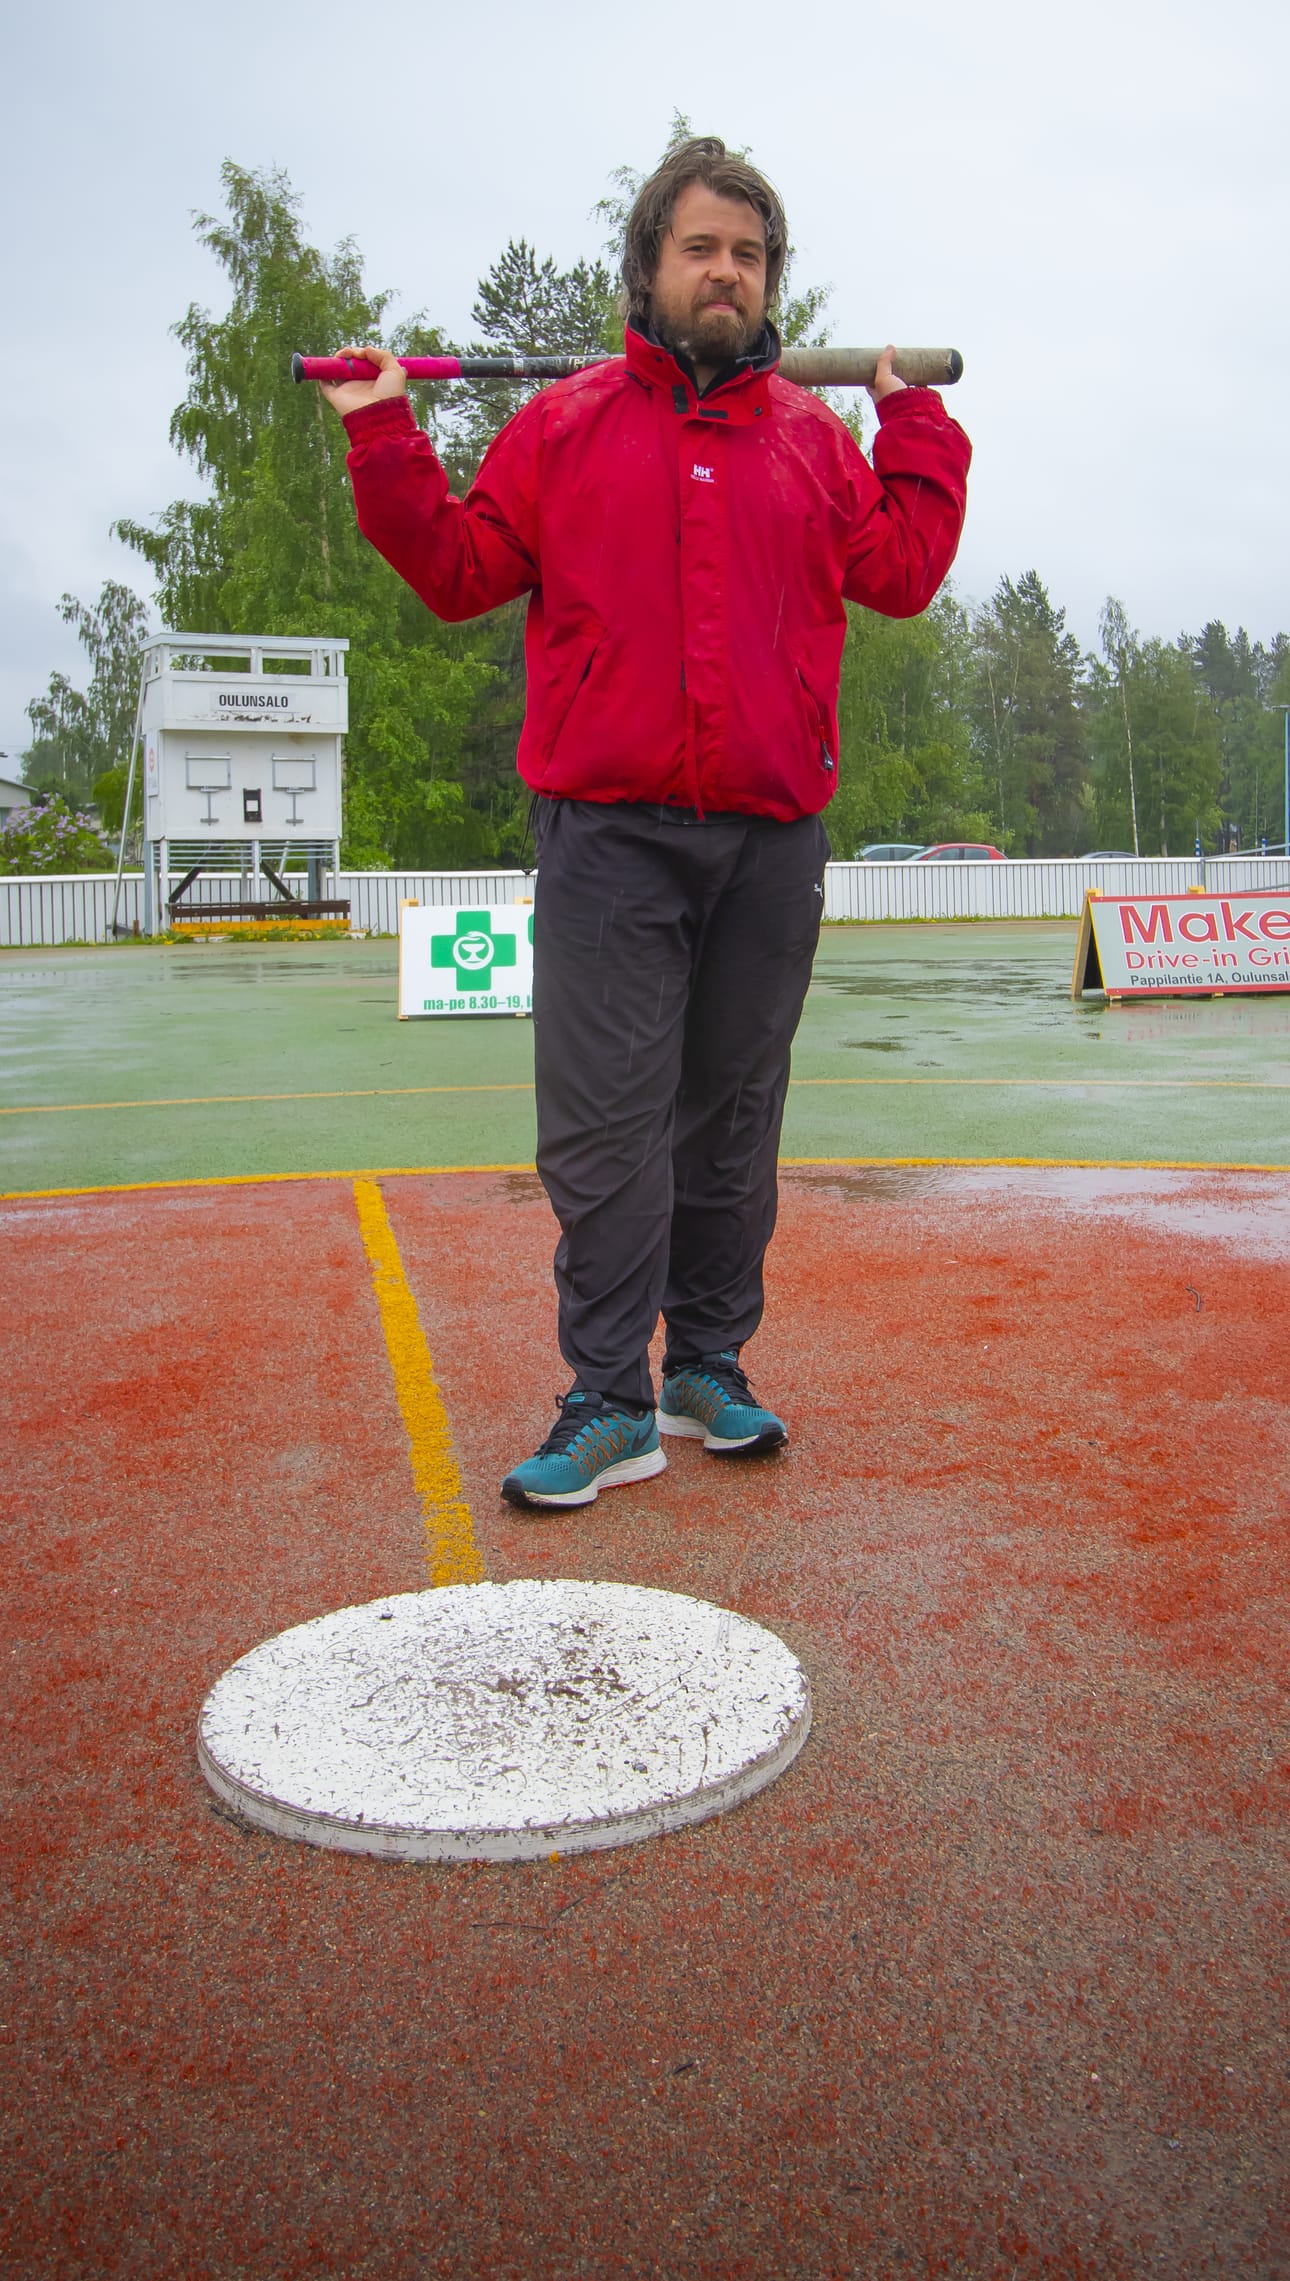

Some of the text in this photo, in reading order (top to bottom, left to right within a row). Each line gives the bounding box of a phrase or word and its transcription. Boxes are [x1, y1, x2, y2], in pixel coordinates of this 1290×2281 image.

[218, 694, 289, 708] OULUNSALO
[1125, 948, 1238, 969] Drive-in
[1131, 971, 1290, 988] Pappilantie 1A, Oulunsal
[423, 997, 466, 1011] ma-pe
